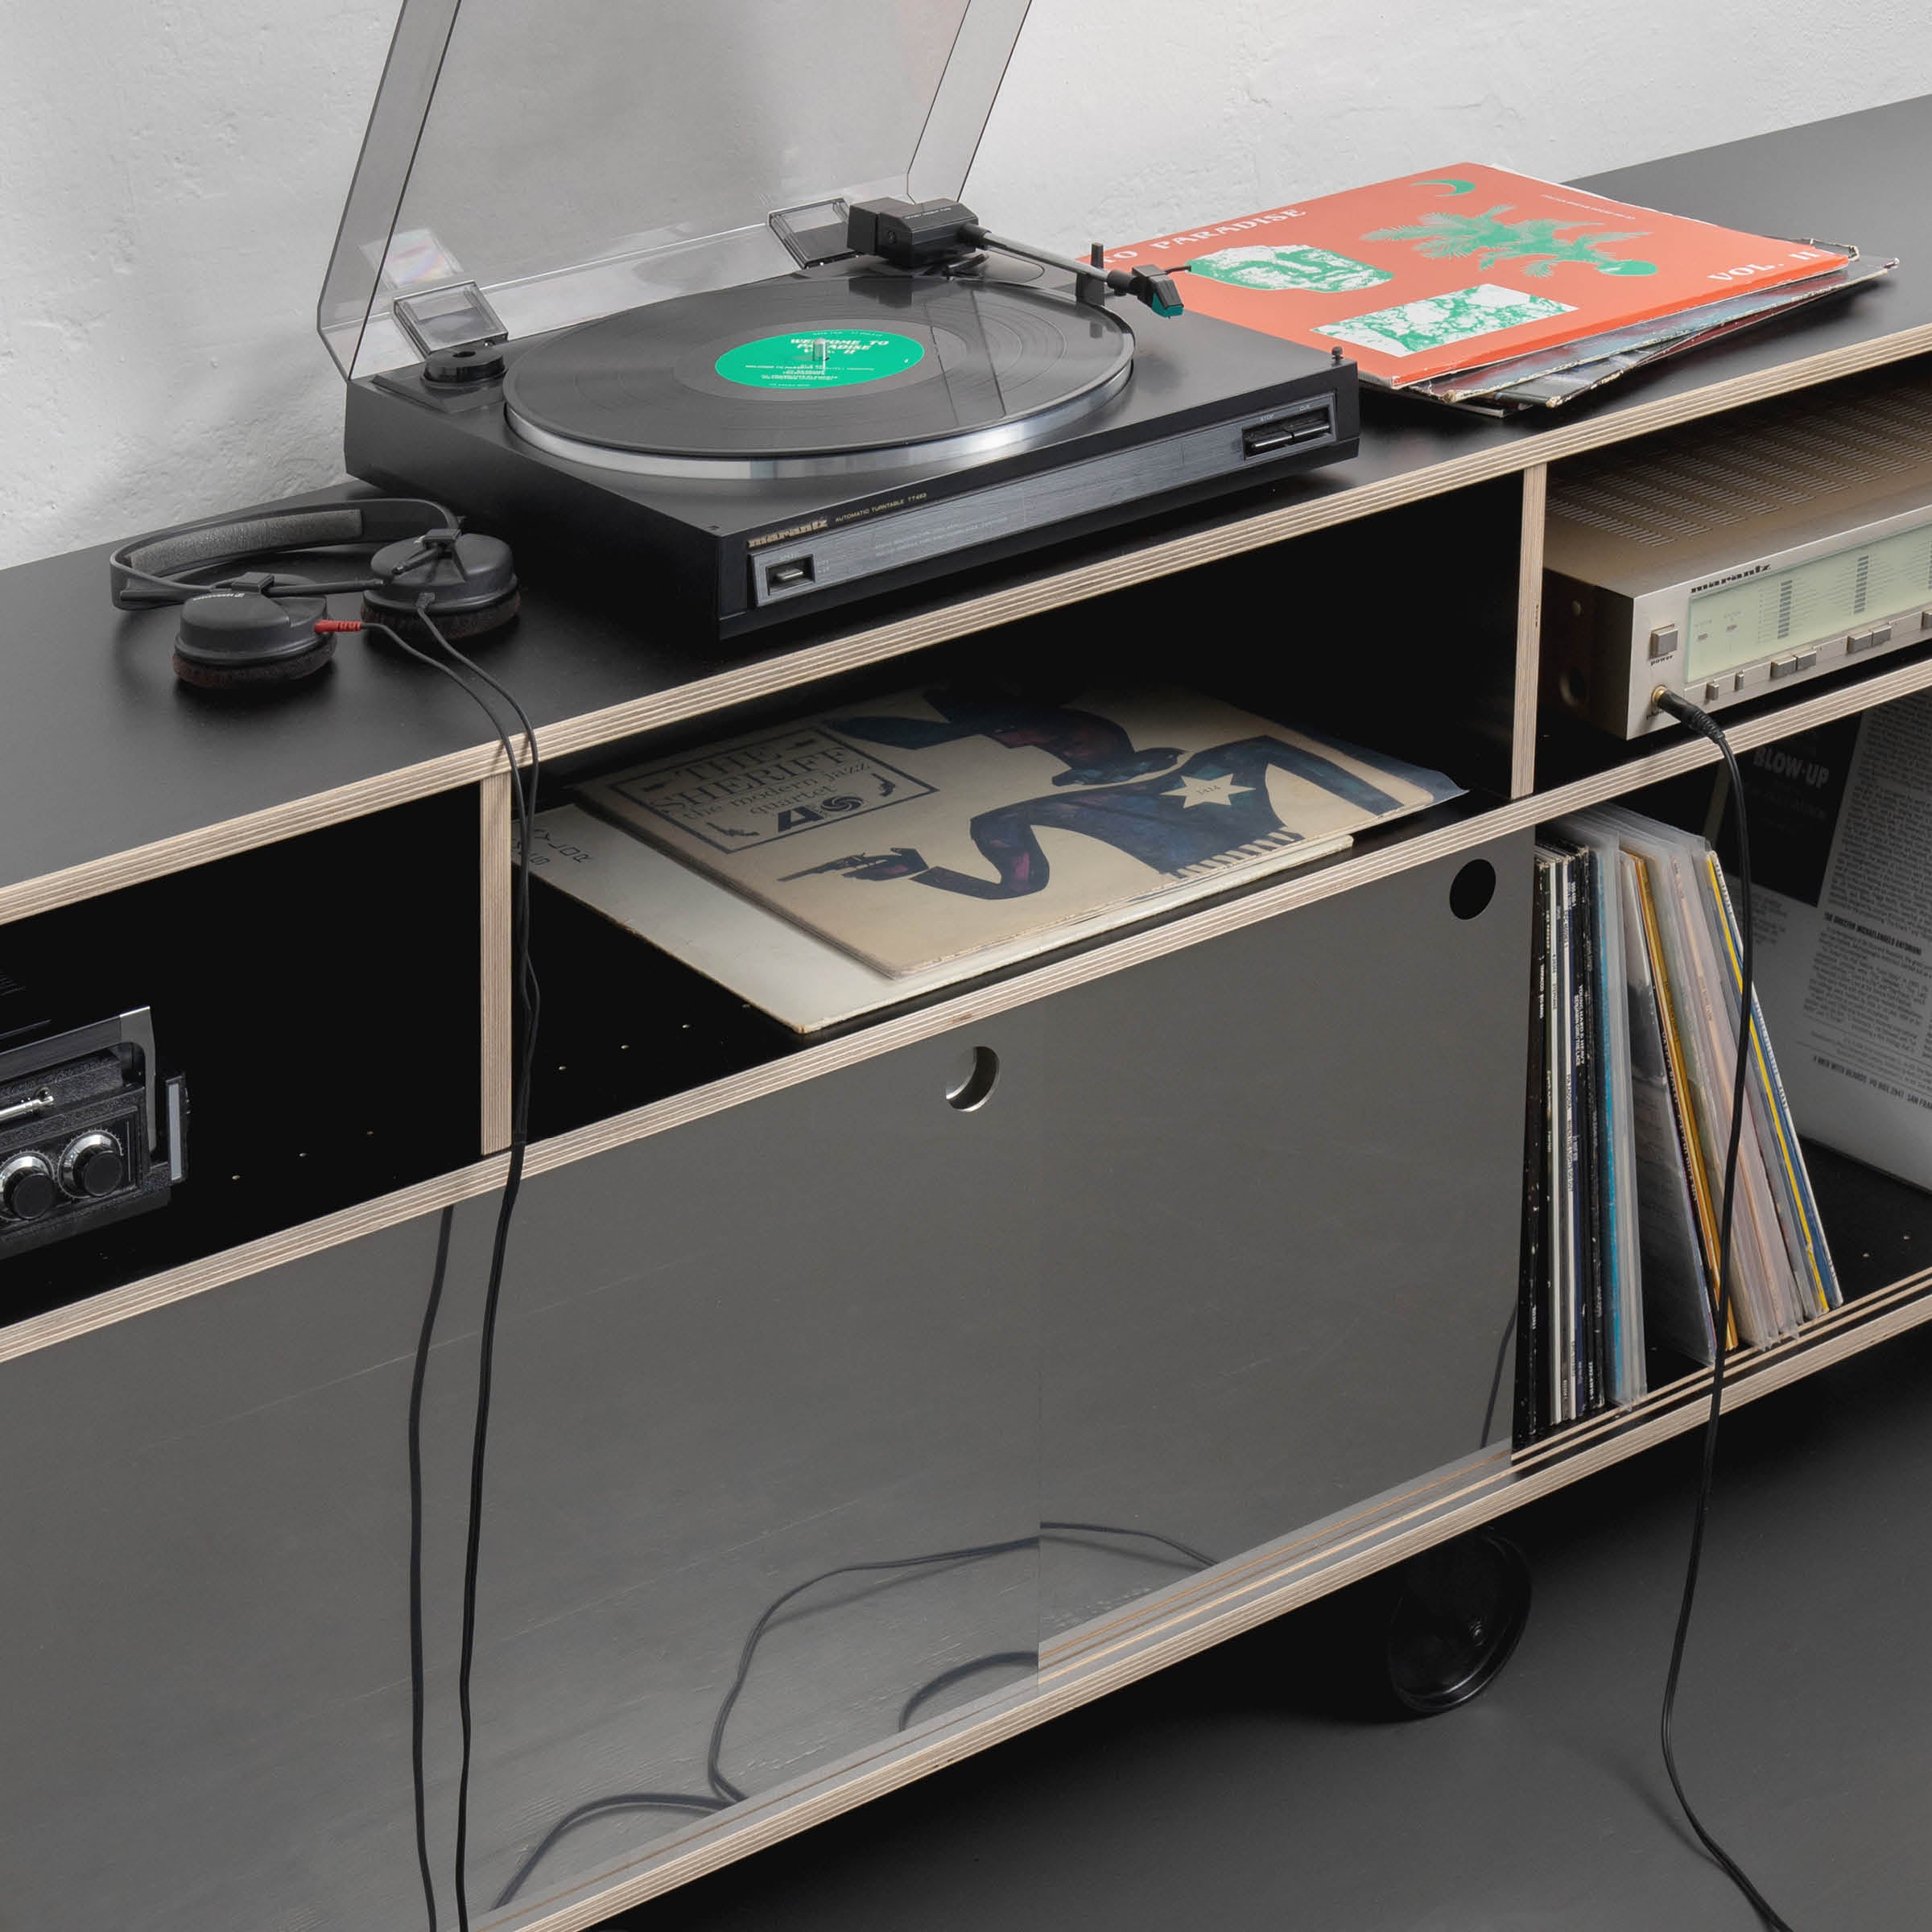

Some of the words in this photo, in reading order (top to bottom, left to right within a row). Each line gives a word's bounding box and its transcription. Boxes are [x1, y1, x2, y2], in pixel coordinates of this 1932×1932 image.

[1150, 208, 1307, 250] PARADISE
[1707, 262, 1784, 281] VOL.
[1788, 251, 1822, 262] II
[835, 508, 870, 523] AUTOMATIC
[871, 498, 906, 514] TURNTABLE
[747, 519, 828, 548] marantz
[1690, 564, 1771, 594] marantz
[1650, 654, 1674, 667] power
[676, 745, 782, 781] THE
[1753, 747, 1830, 790] BLOW-UP
[650, 746, 852, 813] SHERIFF
[682, 803, 722, 819] the
[730, 778, 819, 807] modern
[749, 786, 838, 815] quartet
